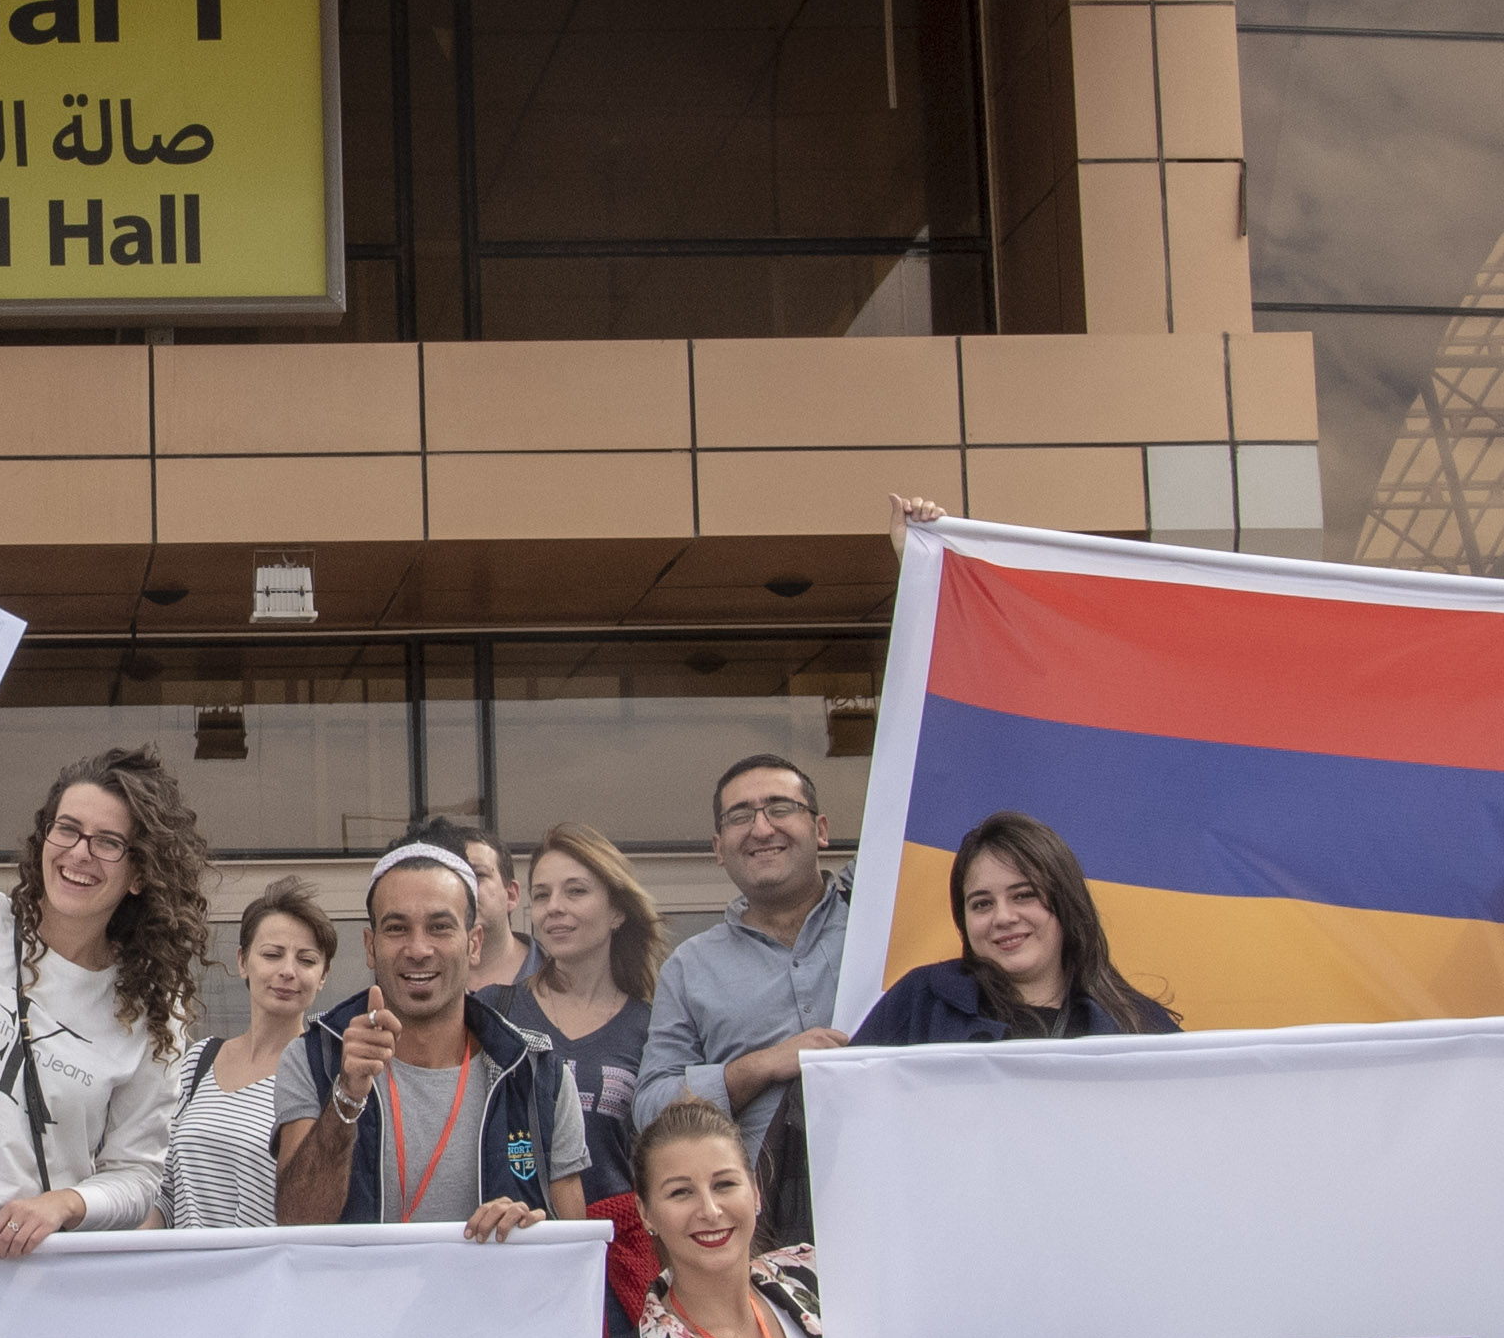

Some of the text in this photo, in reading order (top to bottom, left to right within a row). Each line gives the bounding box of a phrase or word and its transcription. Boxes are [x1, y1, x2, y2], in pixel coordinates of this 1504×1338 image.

[52, 93, 214, 167] صالة
[50, 194, 200, 266] Hall
[42, 1051, 94, 1087] Jeans
